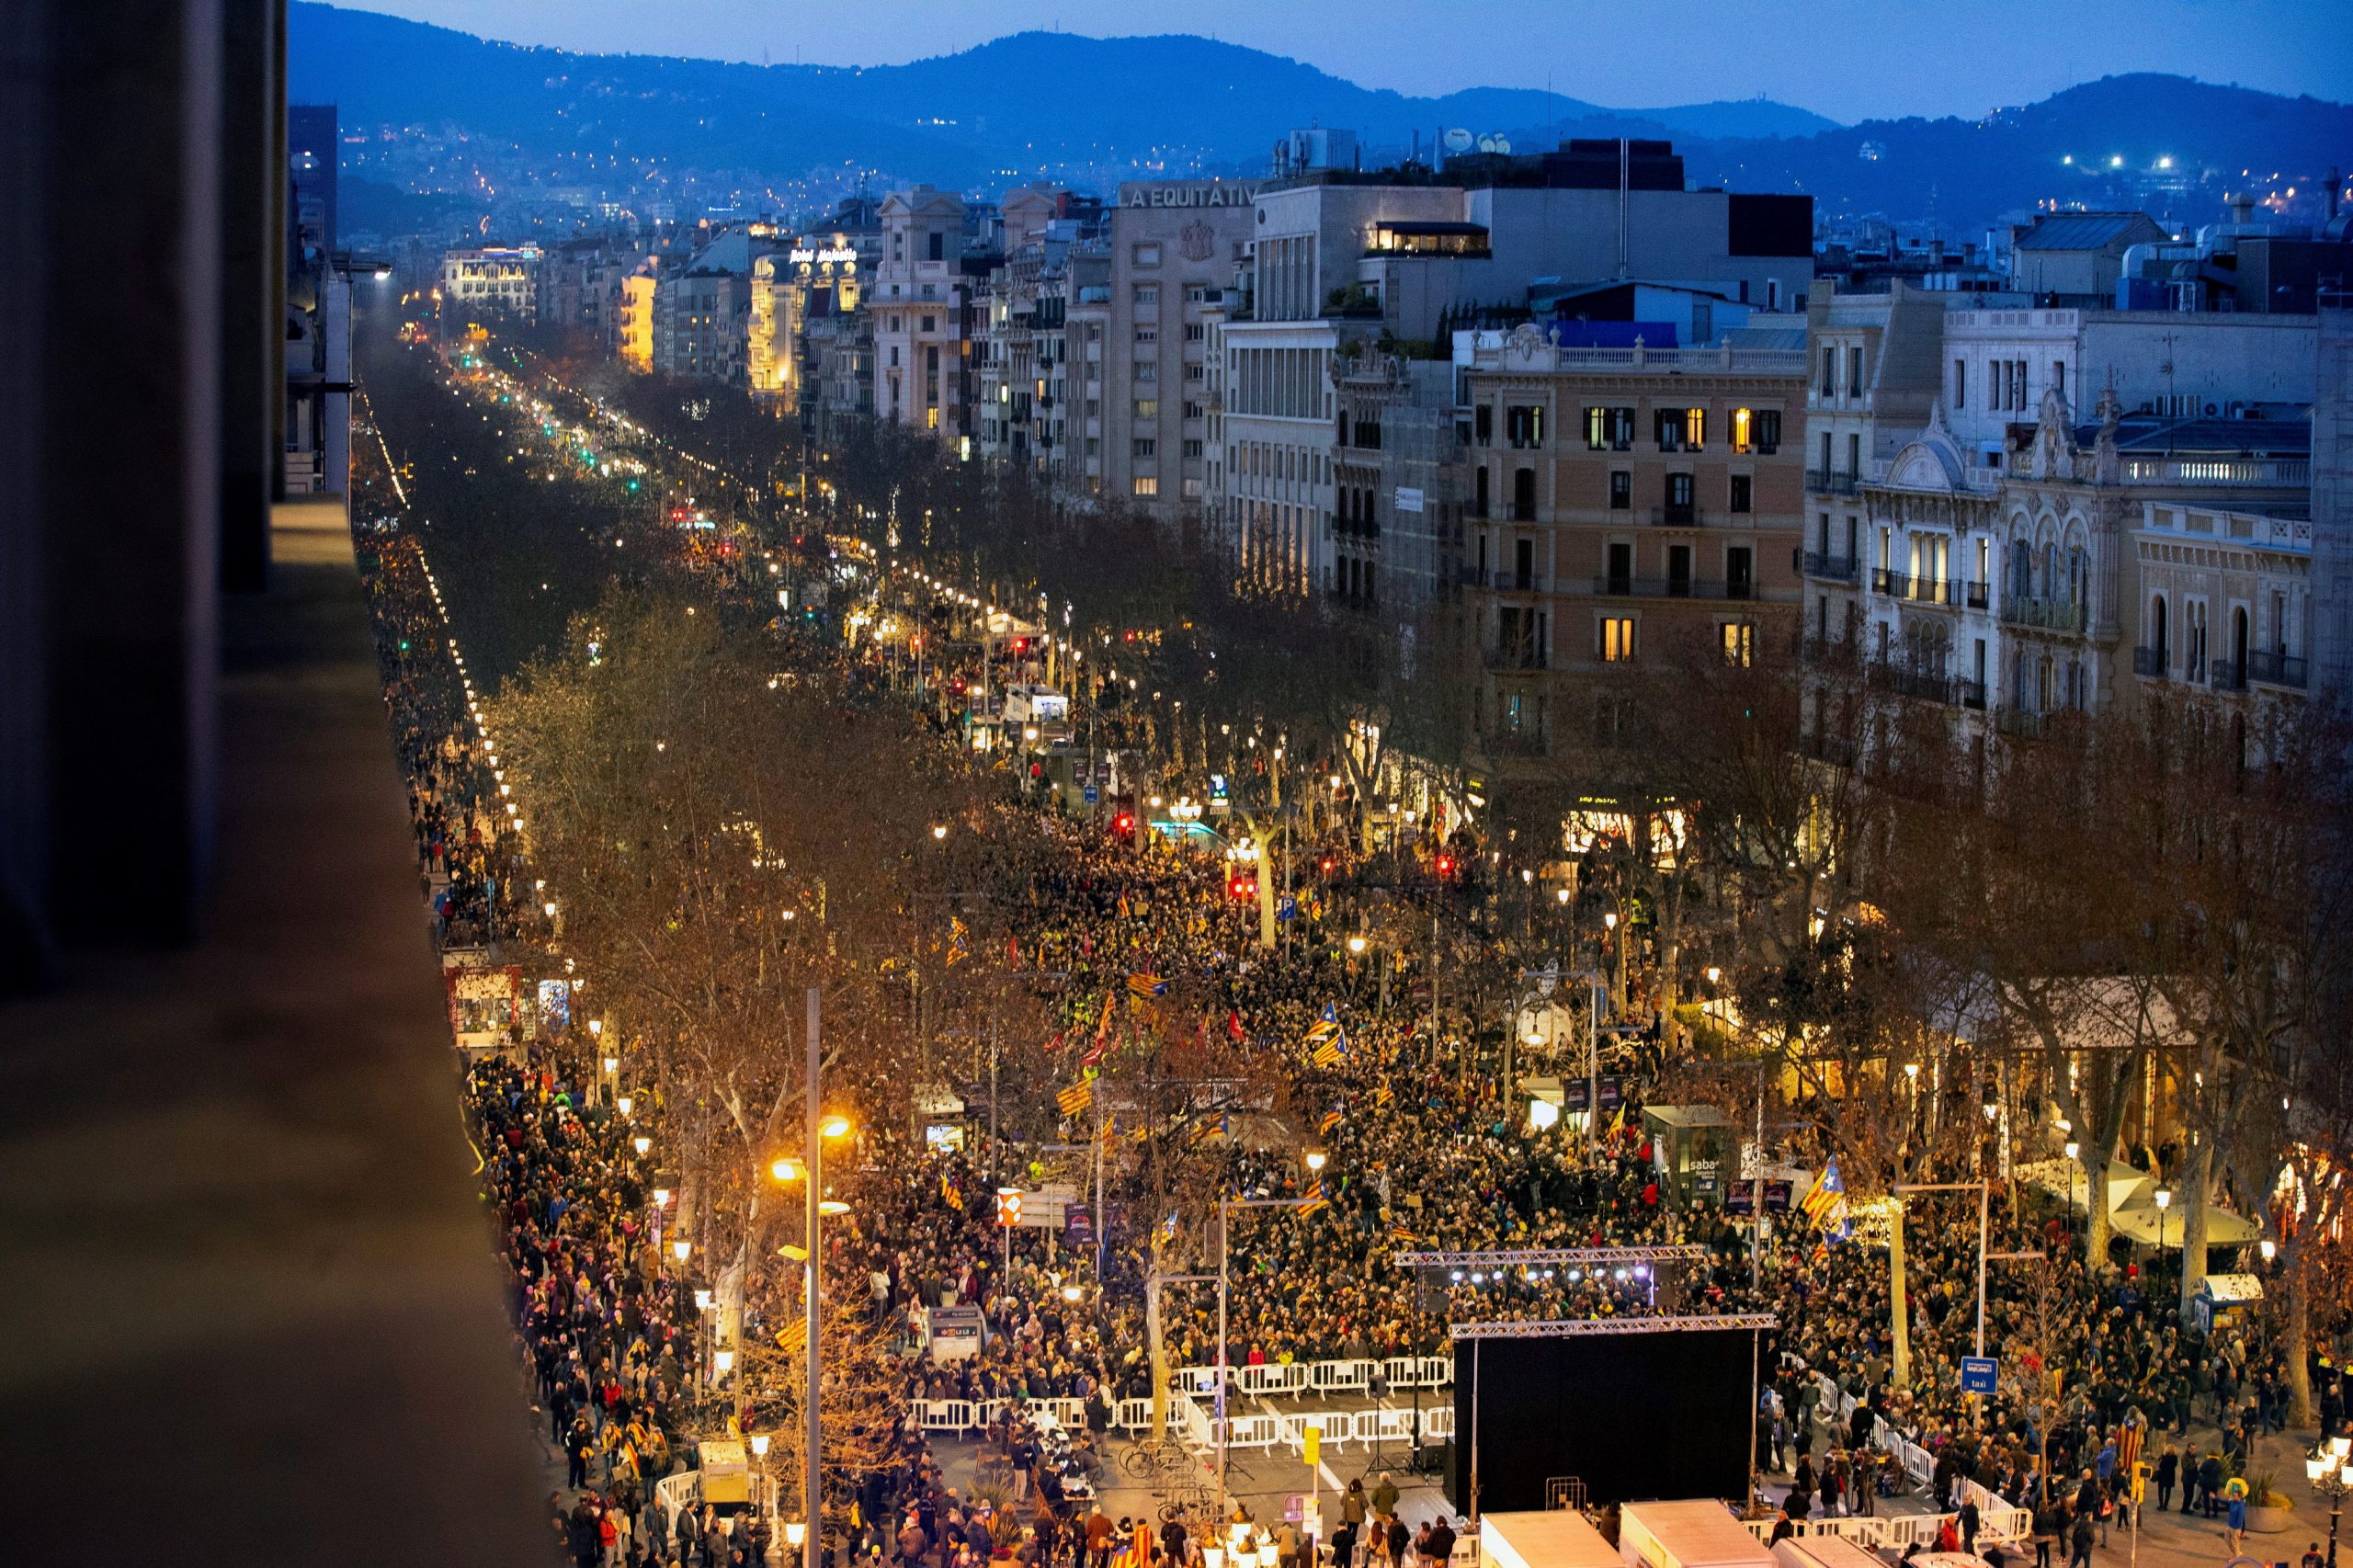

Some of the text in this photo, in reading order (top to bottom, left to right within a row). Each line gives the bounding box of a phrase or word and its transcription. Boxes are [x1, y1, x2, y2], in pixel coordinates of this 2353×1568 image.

[1118, 189, 1144, 207] LA
[790, 248, 857, 264] Hotel Majestic
[1283, 899, 1293, 911] P
[1690, 1158, 1716, 1170] saba
[1972, 1379, 1986, 1388] taxi
